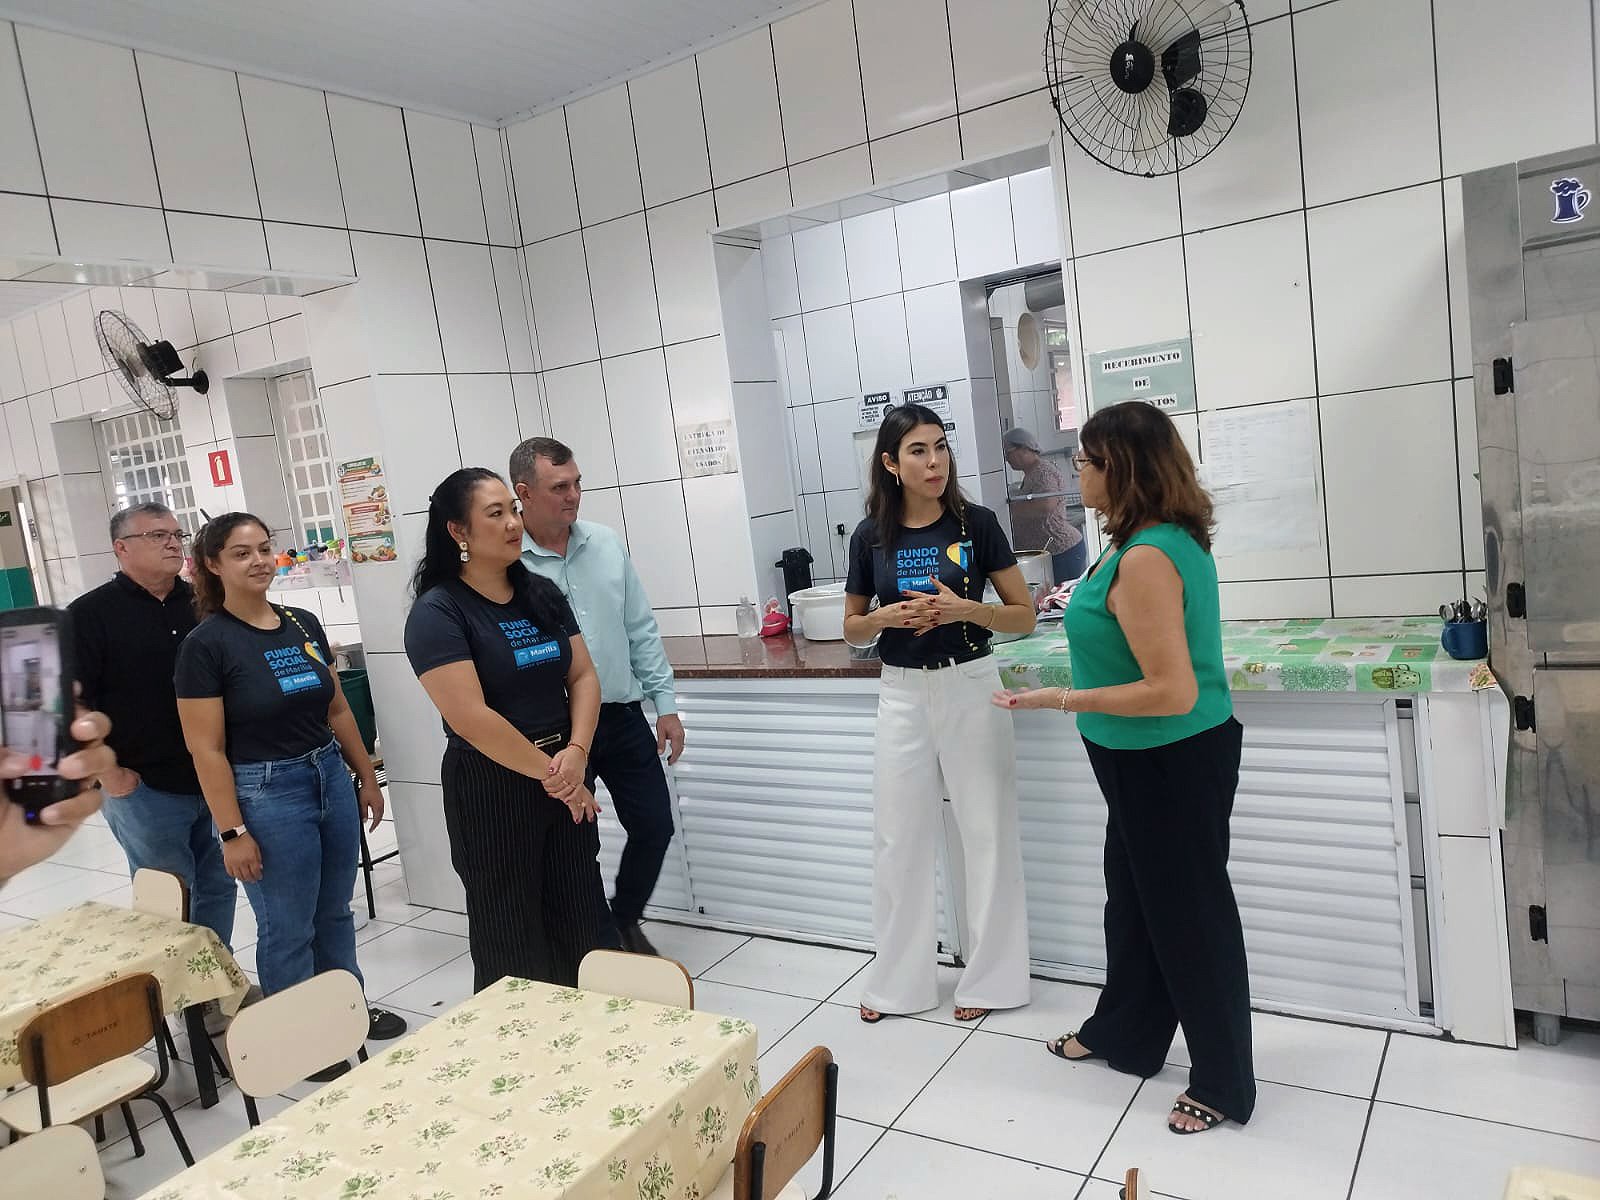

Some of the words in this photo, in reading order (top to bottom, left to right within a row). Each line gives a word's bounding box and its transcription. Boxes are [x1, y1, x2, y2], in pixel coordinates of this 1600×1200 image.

[1104, 352, 1180, 371] RECEBIMENTO
[1134, 379, 1150, 388] DE
[867, 394, 888, 405] AVISO
[907, 389, 933, 402] ATENÇÃO
[897, 546, 939, 559] FUNDO
[897, 557, 939, 569] SOCIAL
[897, 568, 908, 576] de
[498, 619, 531, 632] FUND
[510, 639, 522, 649] de
[264, 645, 301, 661] FUNDO
[269, 655, 308, 670] SOCIAL
[274, 668, 286, 677] de
